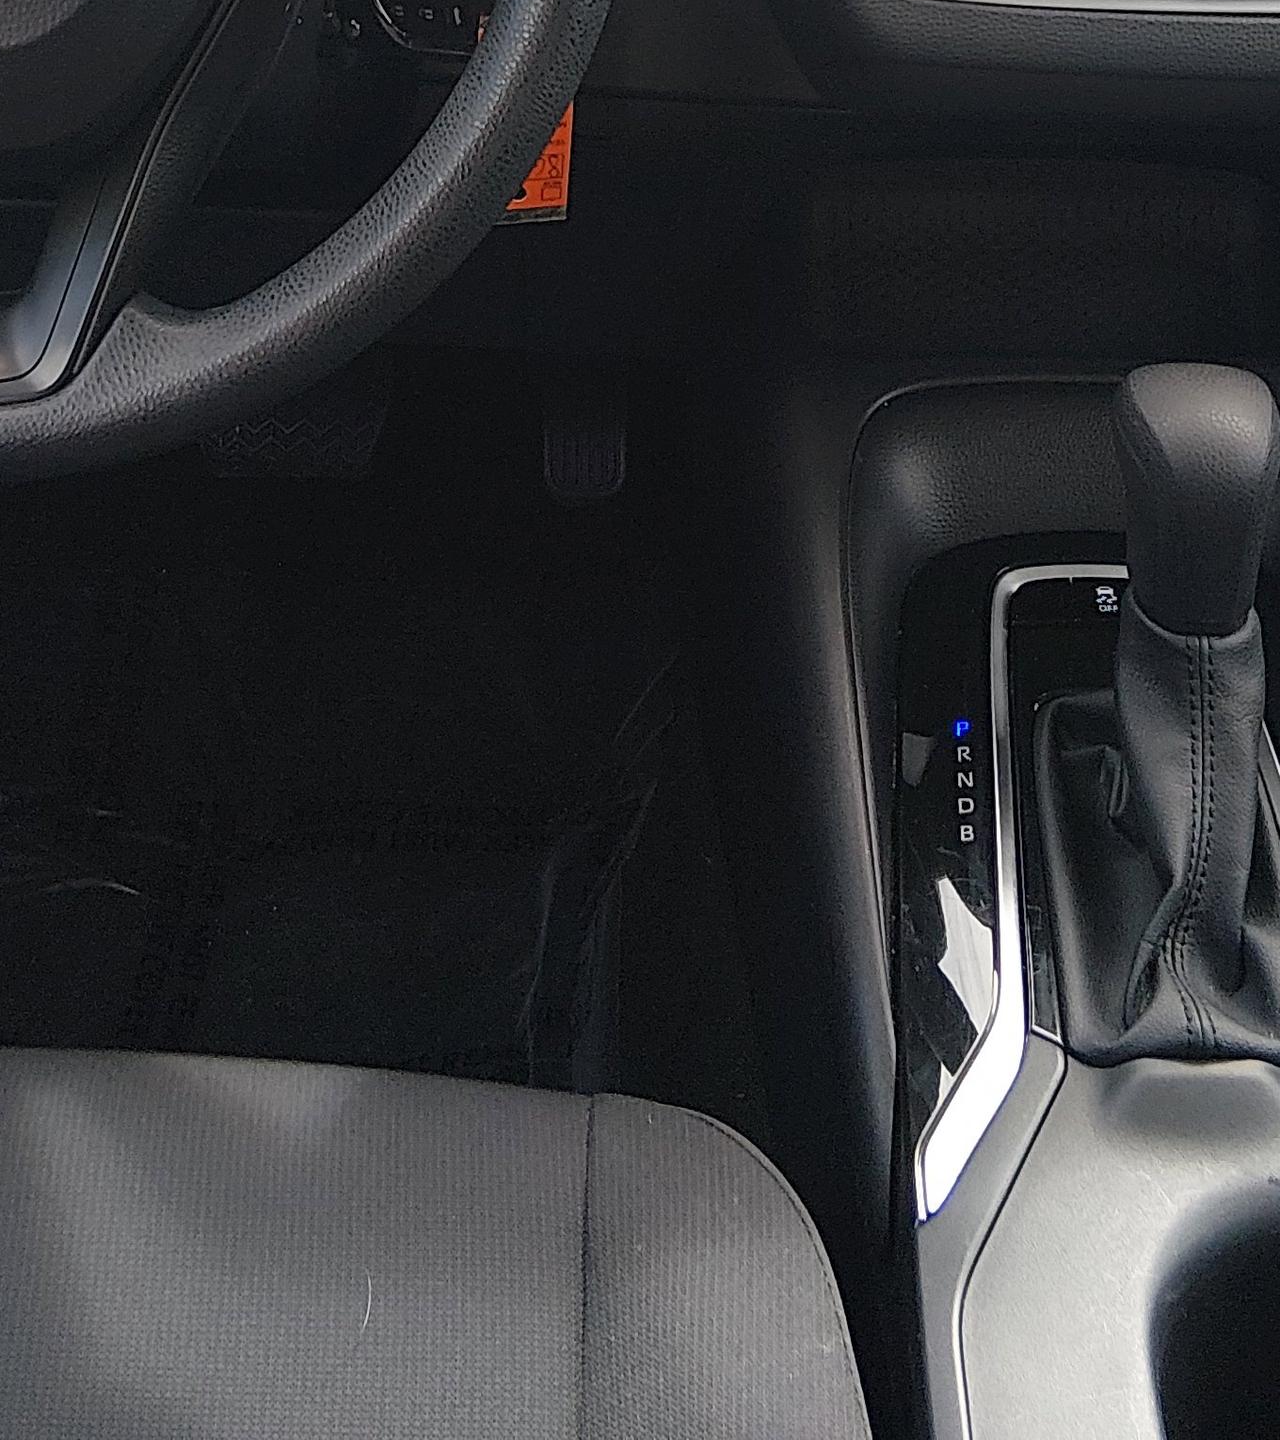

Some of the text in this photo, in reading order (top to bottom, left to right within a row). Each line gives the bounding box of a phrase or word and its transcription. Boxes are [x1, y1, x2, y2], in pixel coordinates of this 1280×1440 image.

[956, 721, 970, 737] P
[956, 745, 973, 763] R
[957, 770, 975, 788] N
[957, 797, 975, 815] D
[959, 824, 976, 843] B
